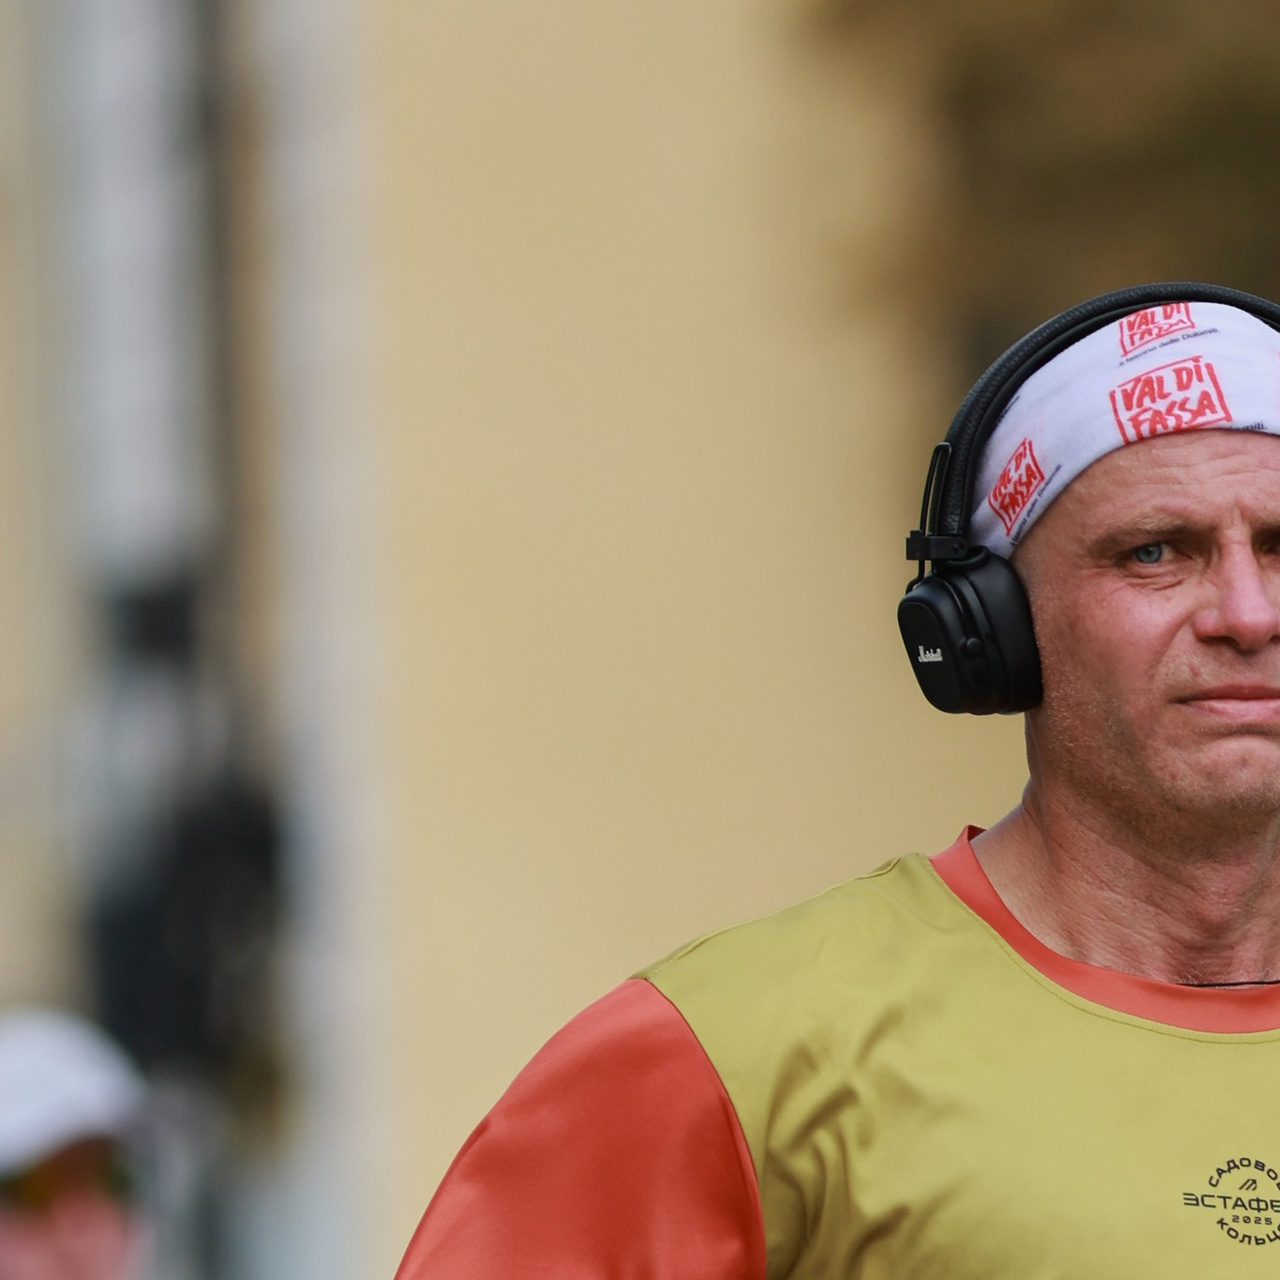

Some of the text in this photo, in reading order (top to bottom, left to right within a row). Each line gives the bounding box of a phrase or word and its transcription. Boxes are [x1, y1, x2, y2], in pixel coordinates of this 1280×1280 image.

[1120, 374, 1172, 412] VAL
[1128, 389, 1219, 441] FASSA
[1231, 1214, 1274, 1226] 2025
